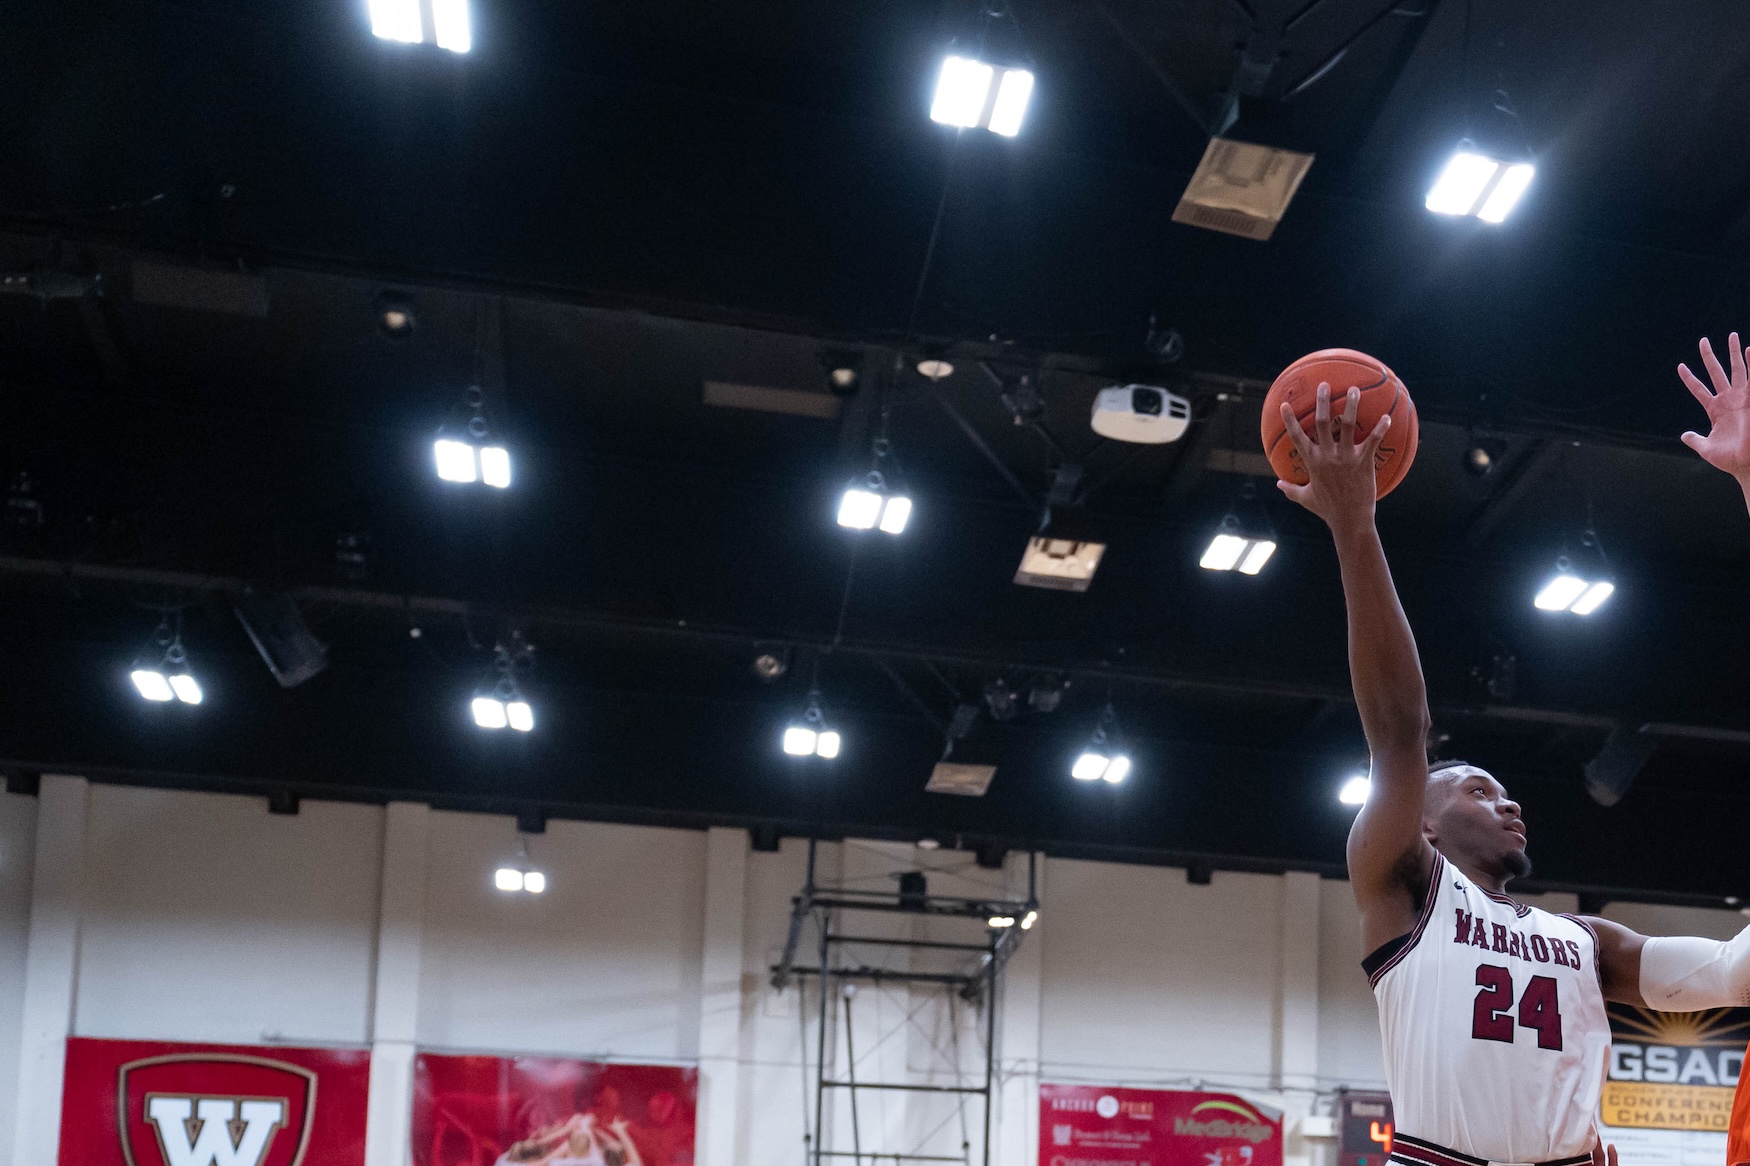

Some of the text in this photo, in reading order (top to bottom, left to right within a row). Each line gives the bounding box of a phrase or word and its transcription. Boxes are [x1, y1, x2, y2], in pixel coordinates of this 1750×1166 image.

[1453, 908, 1582, 971] WARRIORS
[1471, 963, 1563, 1052] 24
[1608, 1094, 1735, 1112] CONFERENC
[1617, 1109, 1728, 1126] CHAMPIO
